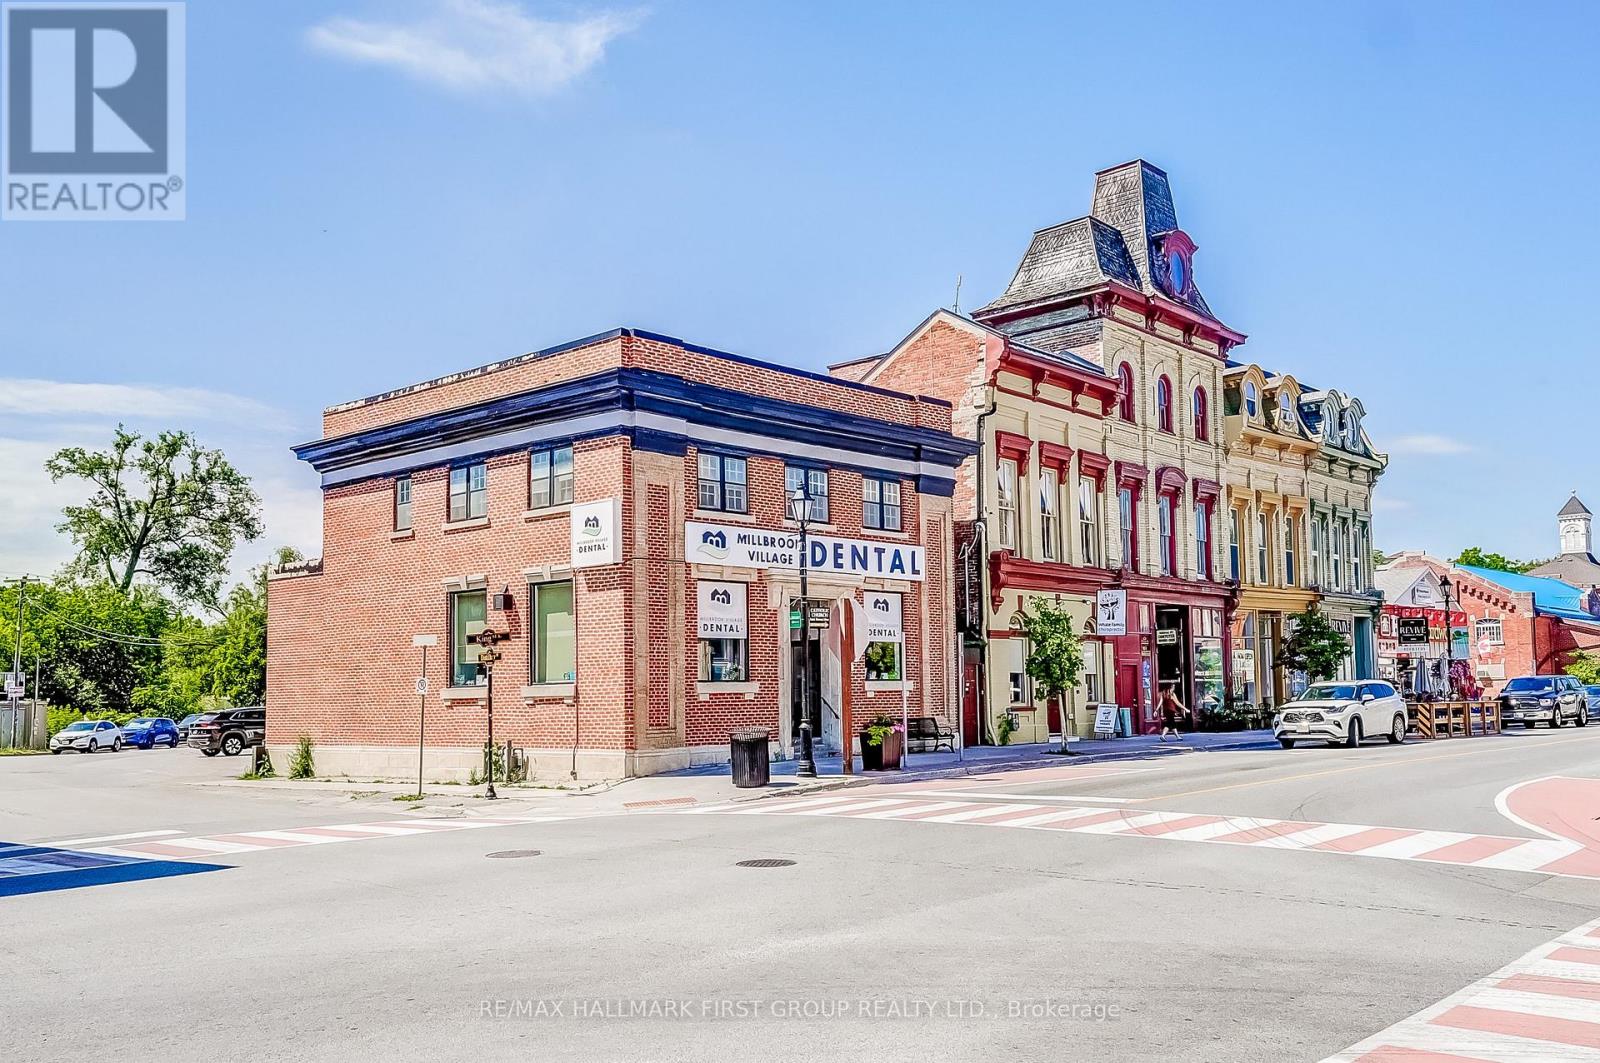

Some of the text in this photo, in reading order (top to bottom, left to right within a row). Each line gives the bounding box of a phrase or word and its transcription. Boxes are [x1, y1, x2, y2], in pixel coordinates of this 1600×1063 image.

[578, 543, 606, 554] DENTAL
[748, 550, 793, 565] VILLAGE
[811, 540, 921, 576] DENTAL
[703, 623, 740, 633] DENTAL
[868, 628, 897, 637] DENTAL
[1400, 626, 1426, 634] REVIVE
